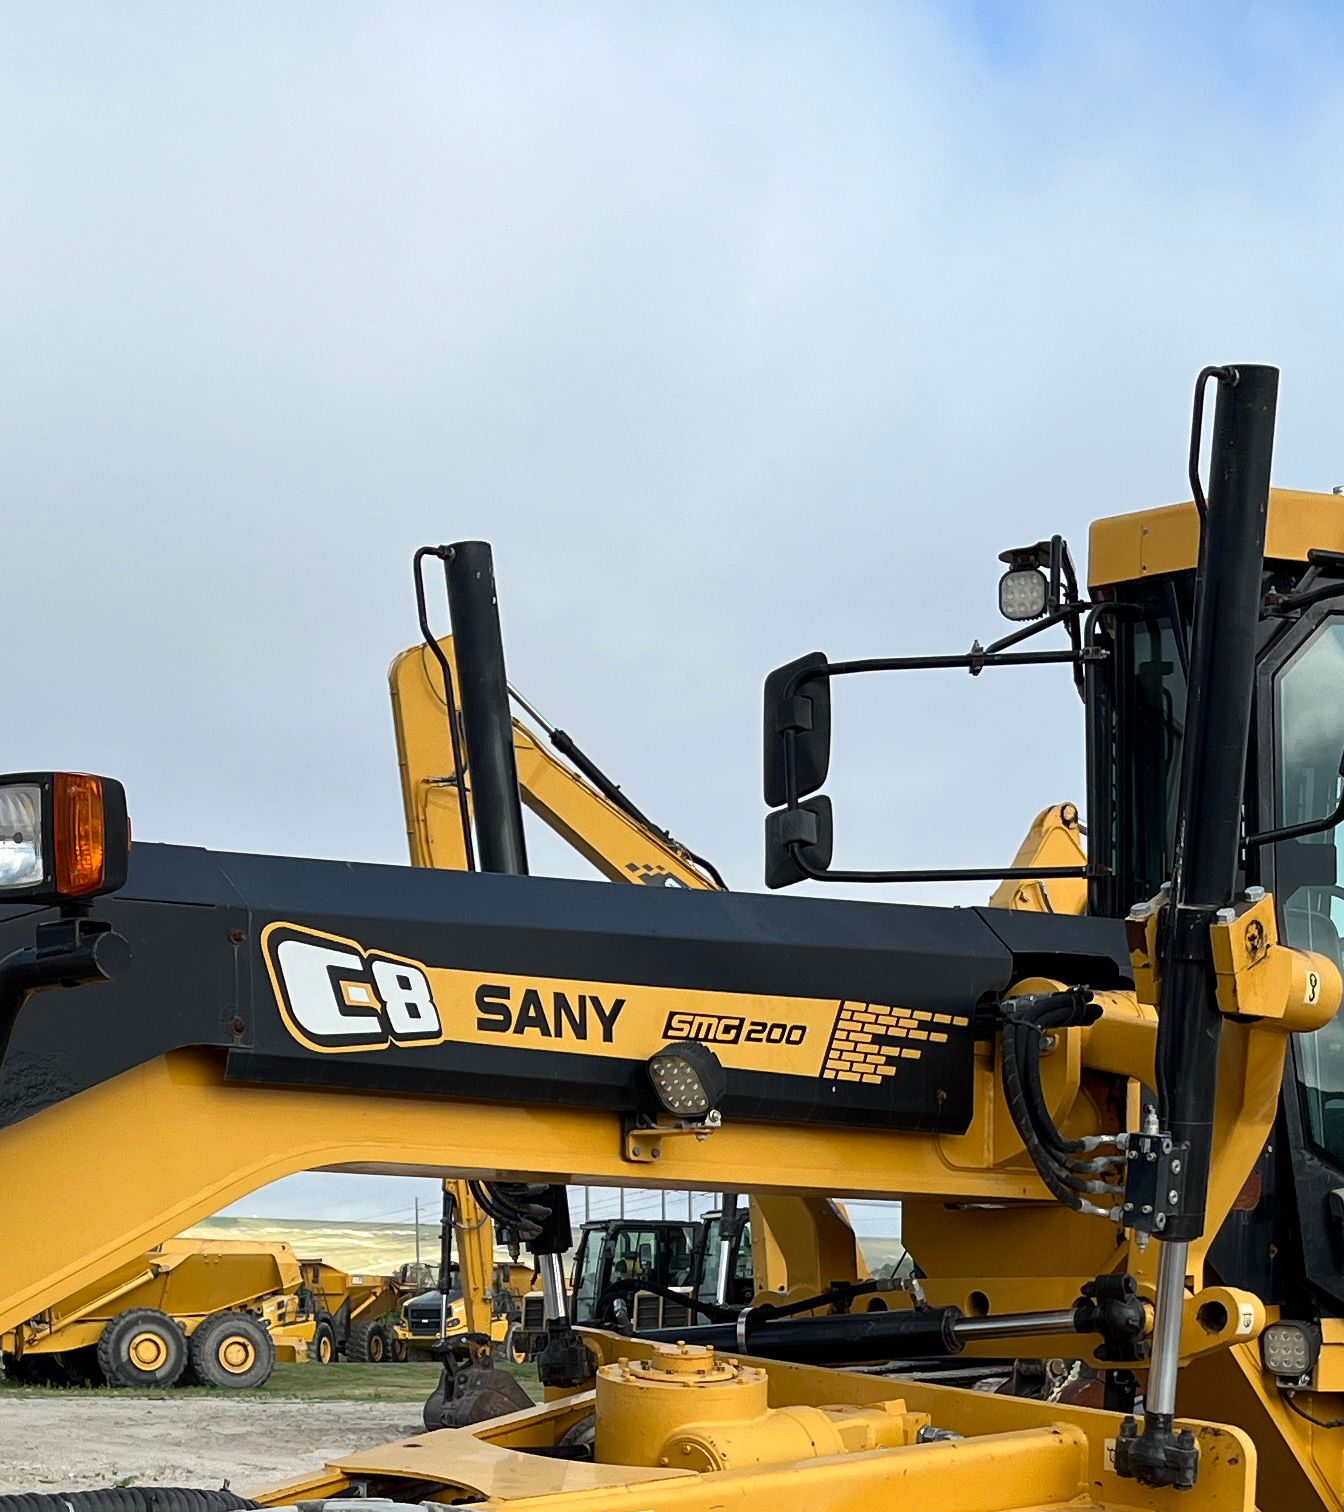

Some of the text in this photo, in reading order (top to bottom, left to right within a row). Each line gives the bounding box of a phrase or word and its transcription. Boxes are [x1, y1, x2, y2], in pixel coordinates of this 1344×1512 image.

[476, 984, 808, 1046] SANY SMG 200
